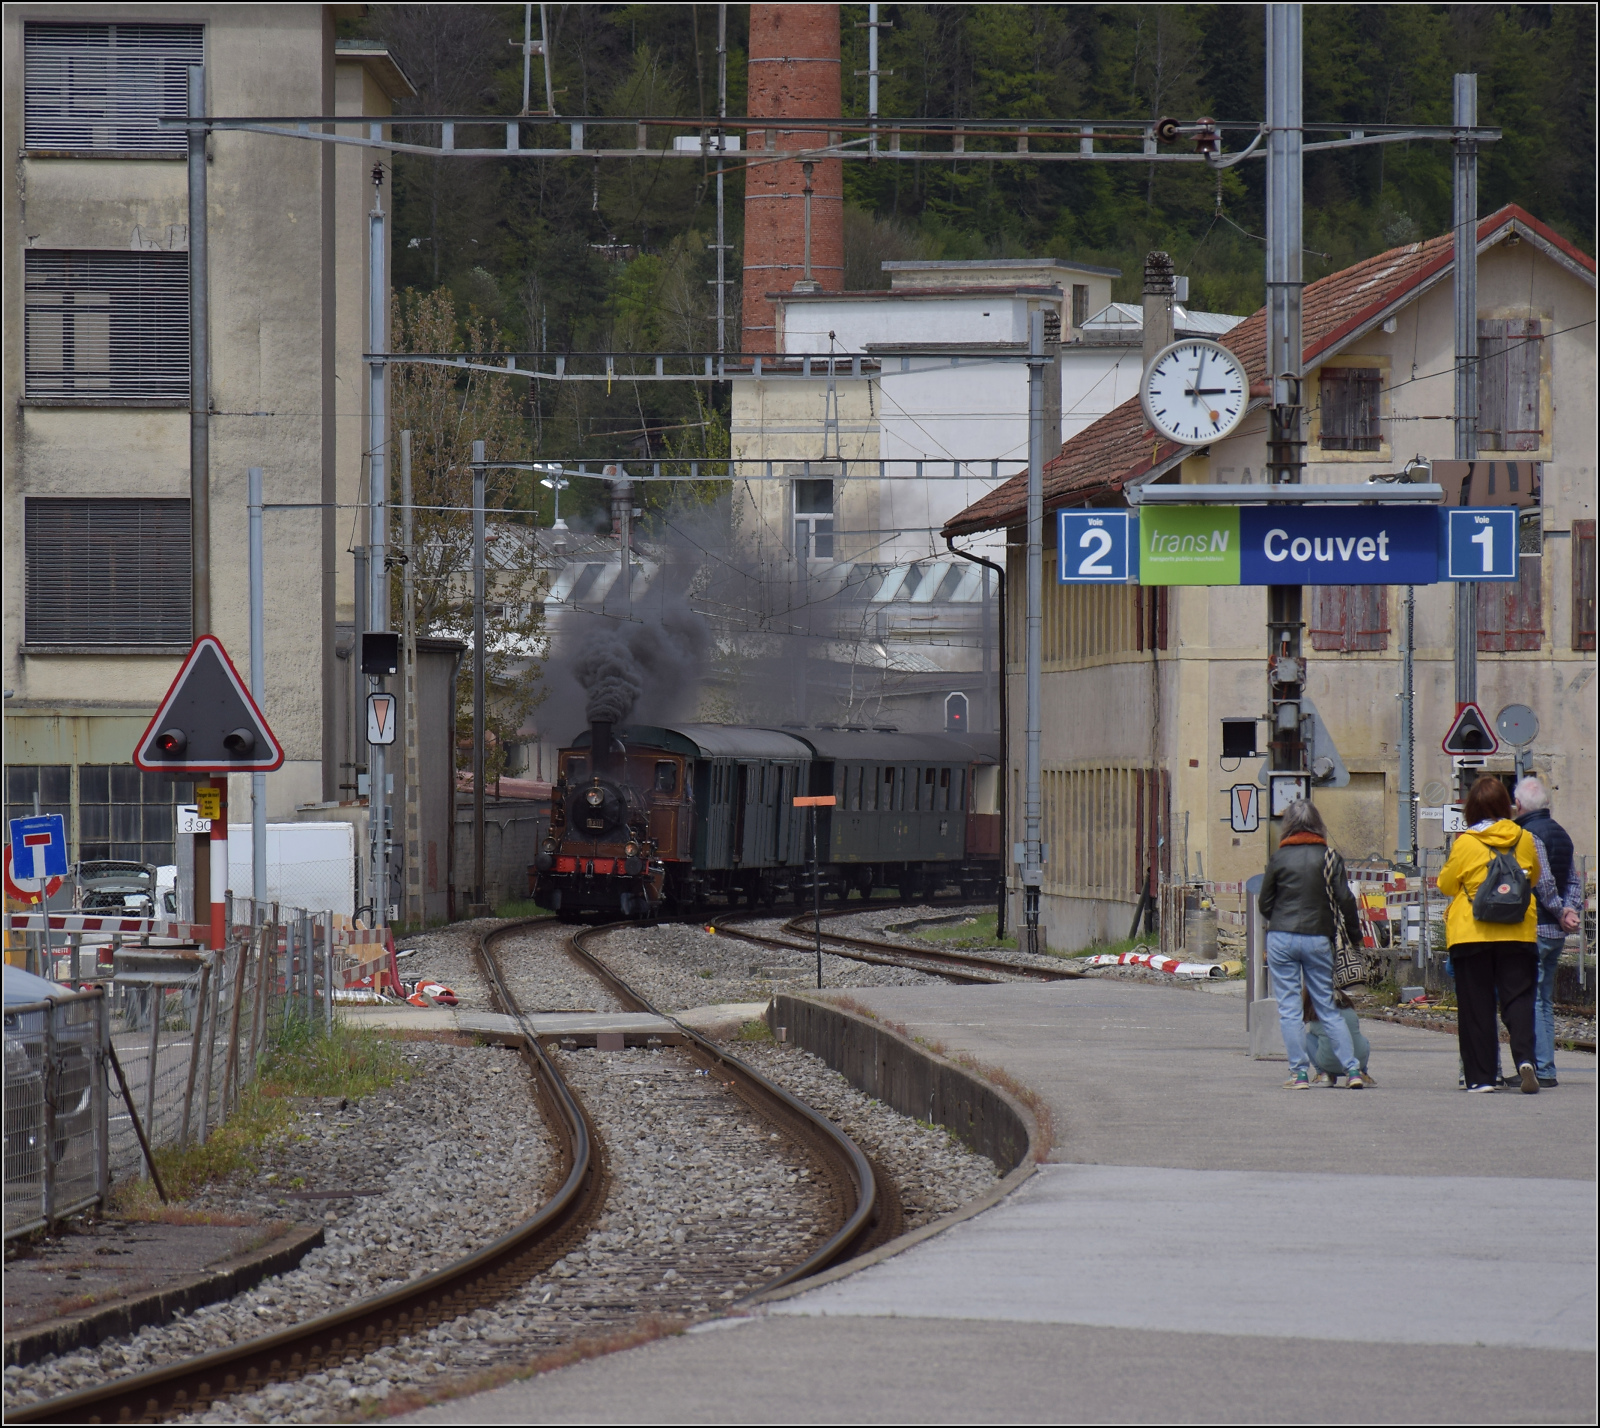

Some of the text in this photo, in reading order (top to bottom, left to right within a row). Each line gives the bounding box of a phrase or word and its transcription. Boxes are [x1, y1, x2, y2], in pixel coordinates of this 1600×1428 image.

[1088, 517, 1104, 526] Voie
[1474, 515, 1490, 524] Voie
[1078, 527, 1113, 575] 2
[1150, 529, 1231, 553] transN
[1263, 528, 1390, 562] Couvet
[1471, 525, 1493, 572] 1
